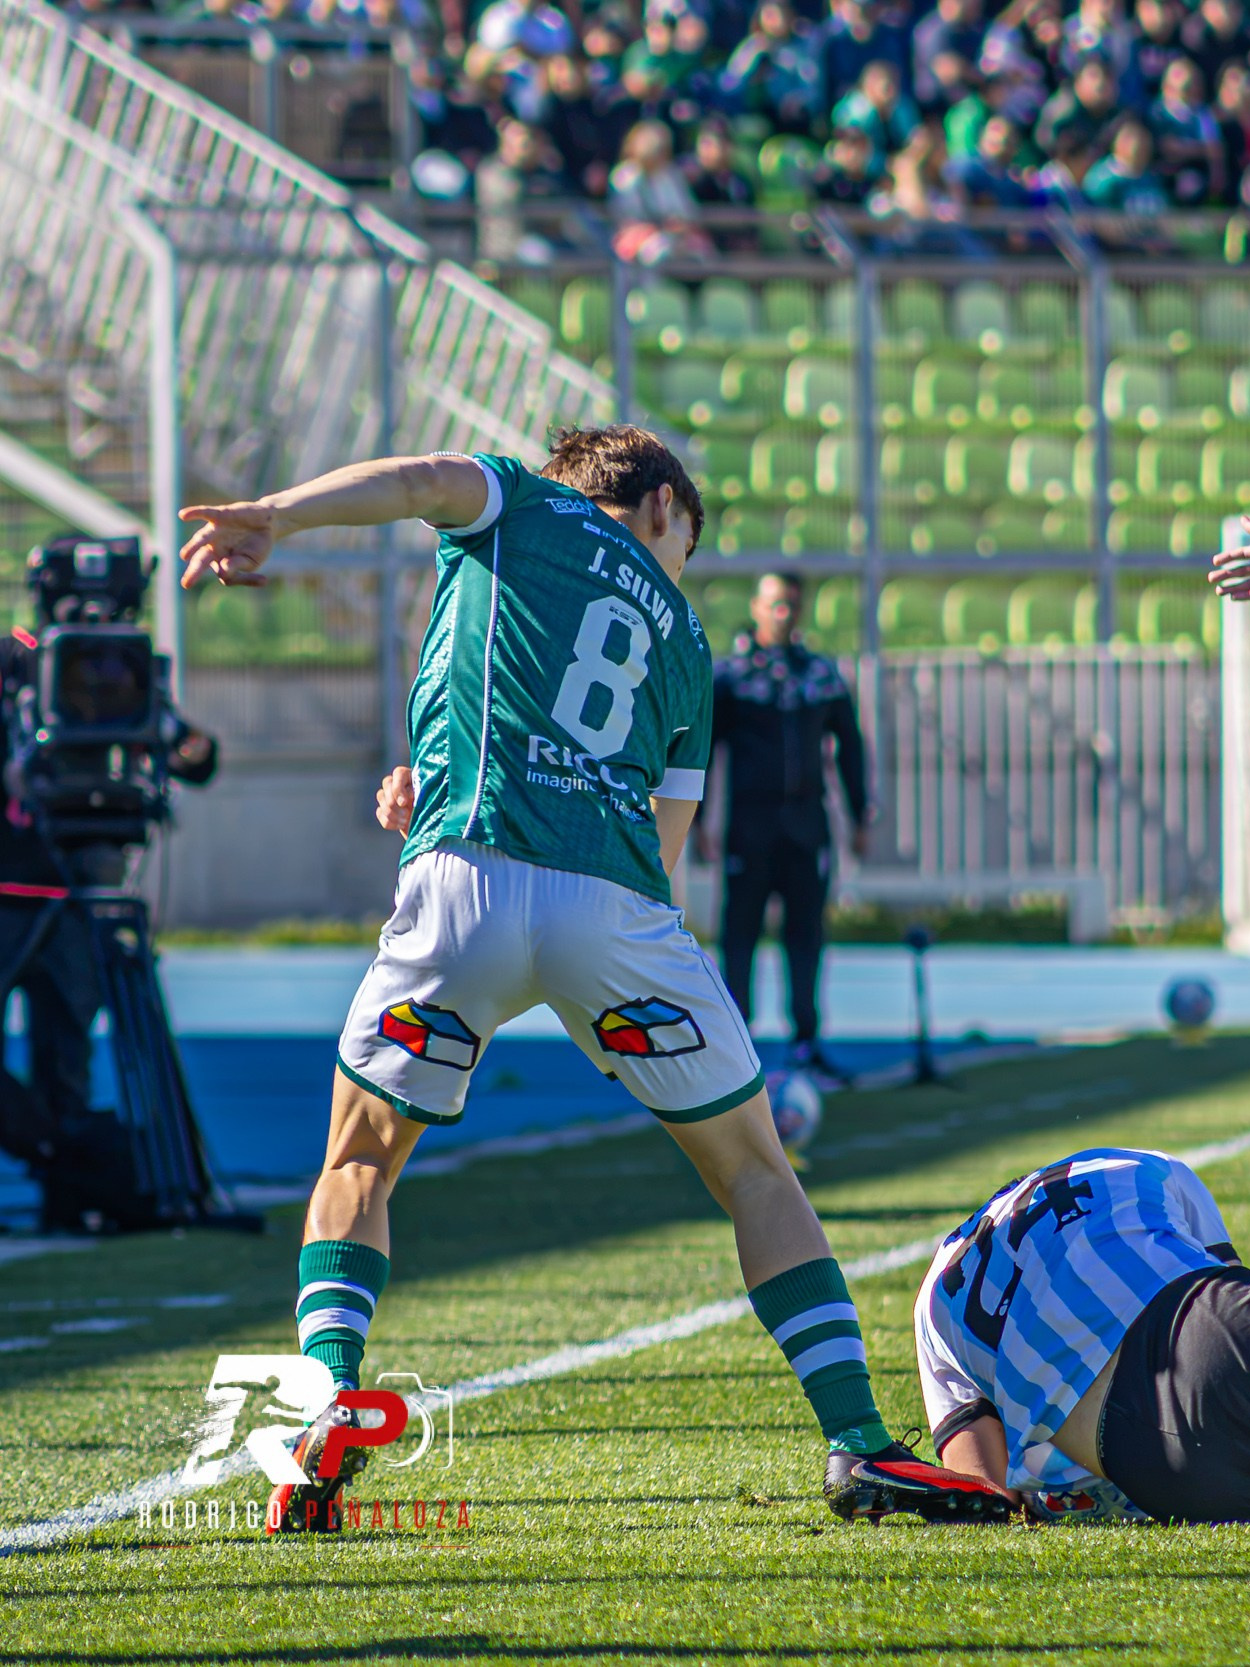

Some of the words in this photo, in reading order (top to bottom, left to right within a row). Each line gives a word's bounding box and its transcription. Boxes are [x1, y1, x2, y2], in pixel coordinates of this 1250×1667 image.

[588, 546, 608, 579] J.
[616, 563, 674, 641] SILVA
[551, 595, 651, 759] 8
